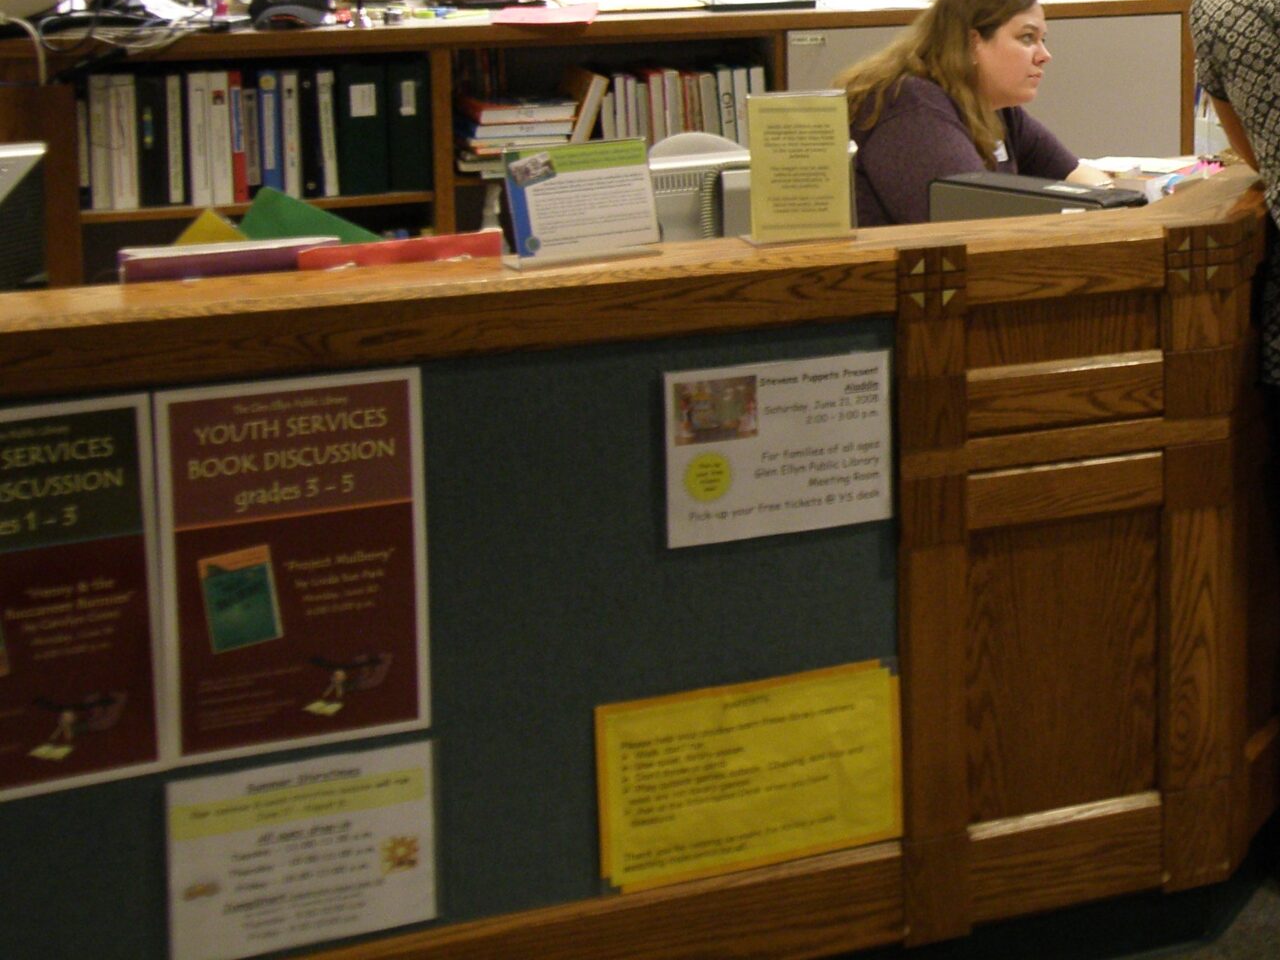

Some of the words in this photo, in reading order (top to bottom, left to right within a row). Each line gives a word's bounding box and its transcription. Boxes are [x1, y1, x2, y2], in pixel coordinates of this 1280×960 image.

[193, 418, 281, 446] YOUTH
[285, 407, 389, 438] SERVICES
[1, 436, 114, 470] SERVICES
[187, 453, 259, 481] BOOK
[263, 436, 396, 474] DISCUSSION
[234, 478, 300, 512] grades
[305, 477, 320, 498] 3
[341, 473, 355, 493] 5
[62, 504, 79, 526] 3
